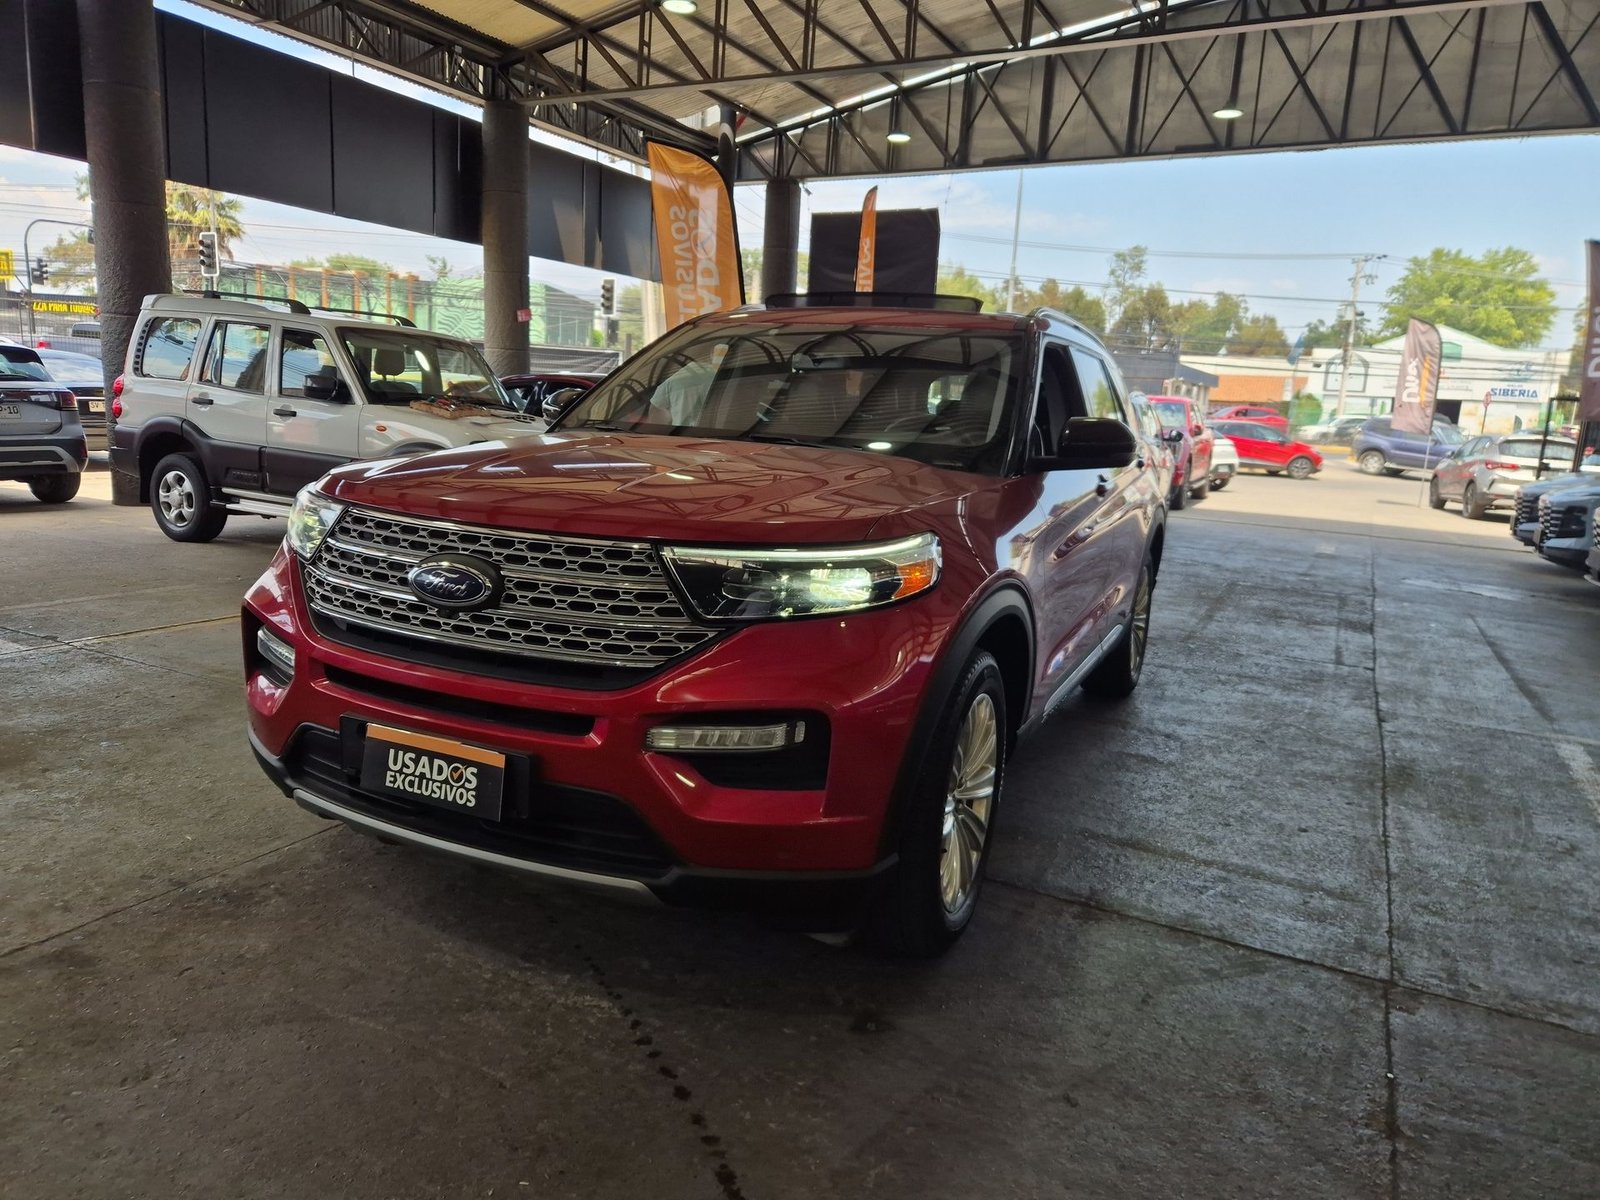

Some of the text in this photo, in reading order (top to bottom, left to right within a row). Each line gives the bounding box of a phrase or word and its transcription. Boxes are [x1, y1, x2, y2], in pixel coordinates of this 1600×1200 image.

[1491, 387, 1538, 398] SIBERIA
[423, 570, 470, 597] Ford
[388, 748, 478, 789] USADOS
[385, 770, 476, 807] EXCLUSIVOS
